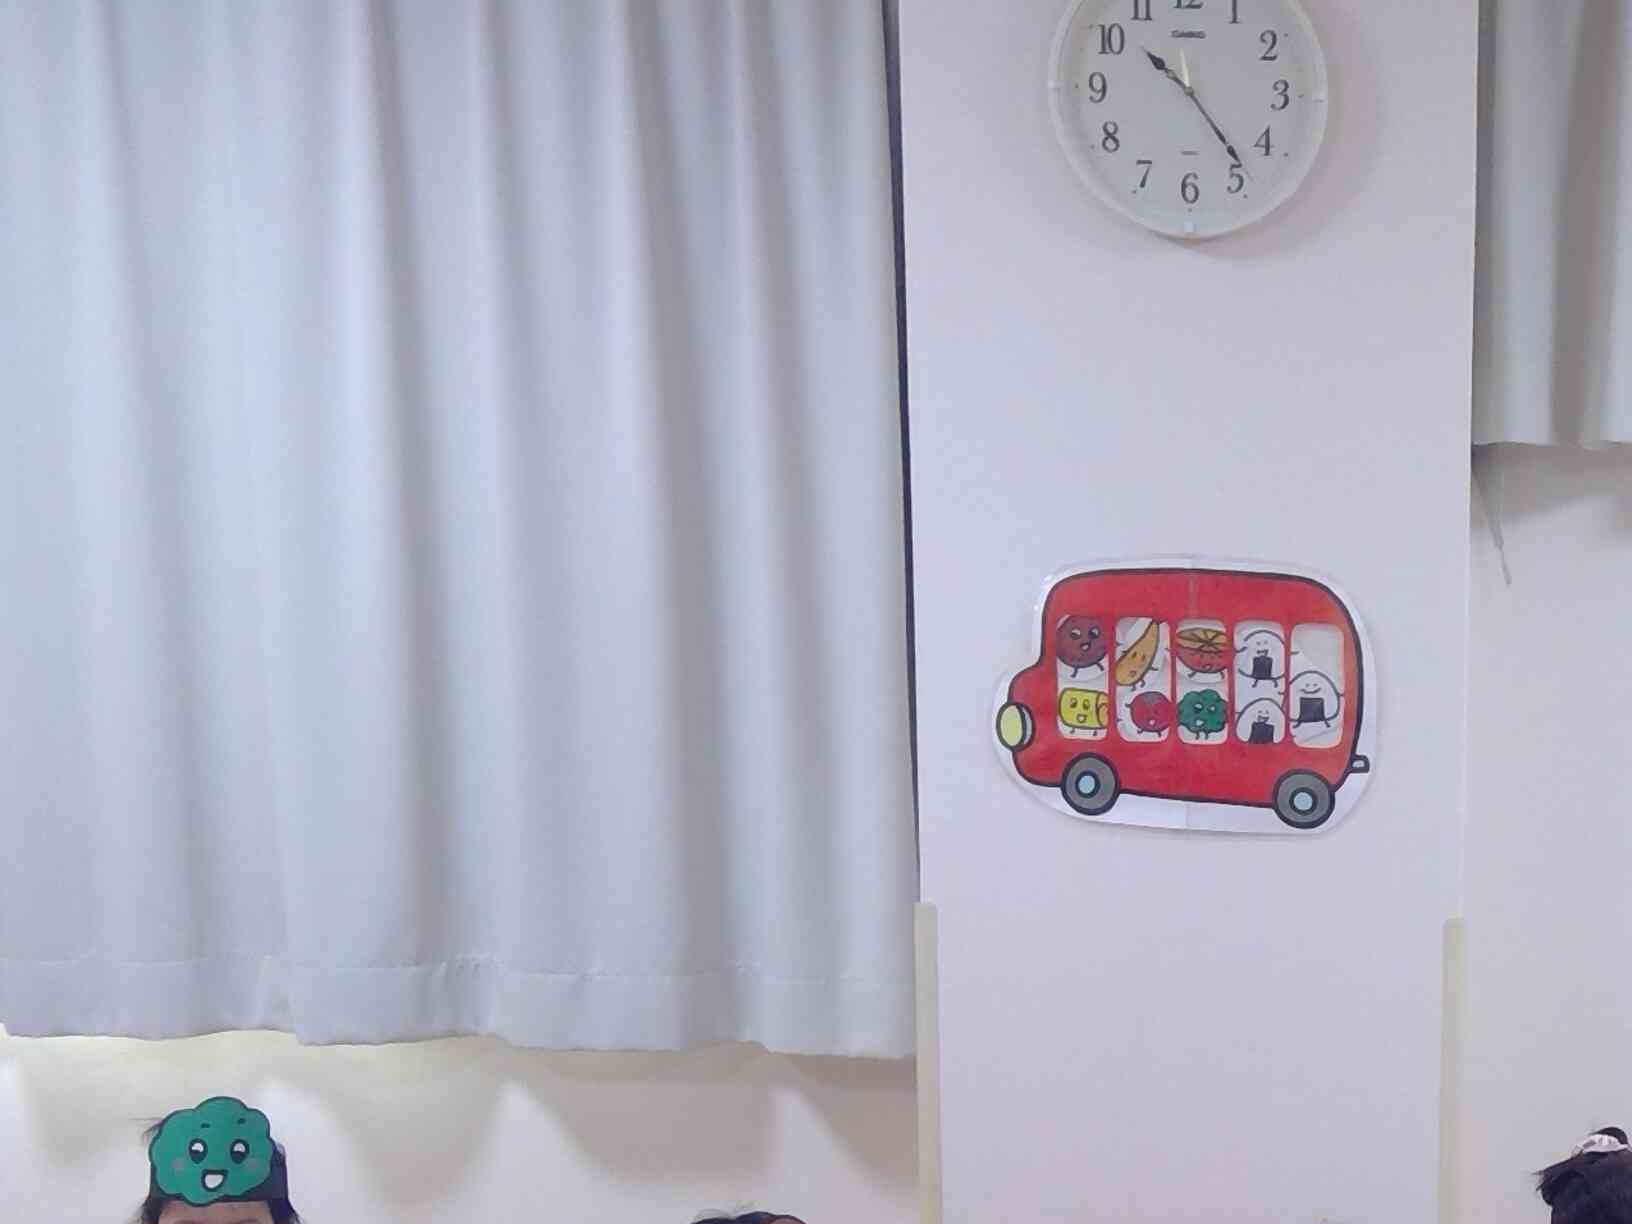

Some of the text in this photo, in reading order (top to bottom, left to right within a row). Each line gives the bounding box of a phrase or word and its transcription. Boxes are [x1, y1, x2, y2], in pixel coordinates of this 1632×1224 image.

[1130, 0, 1153, 21] 11
[1228, 0, 1242, 24] 1
[1098, 22, 1126, 55] 10
[1258, 29, 1279, 61] 2
[1088, 71, 1108, 103] 9
[1270, 79, 1290, 111] 3
[1101, 121, 1121, 153] 8
[1253, 125, 1275, 156] 4
[1136, 159, 1153, 189] 7
[1180, 172, 1200, 205] 6
[1226, 162, 1246, 194] 5
